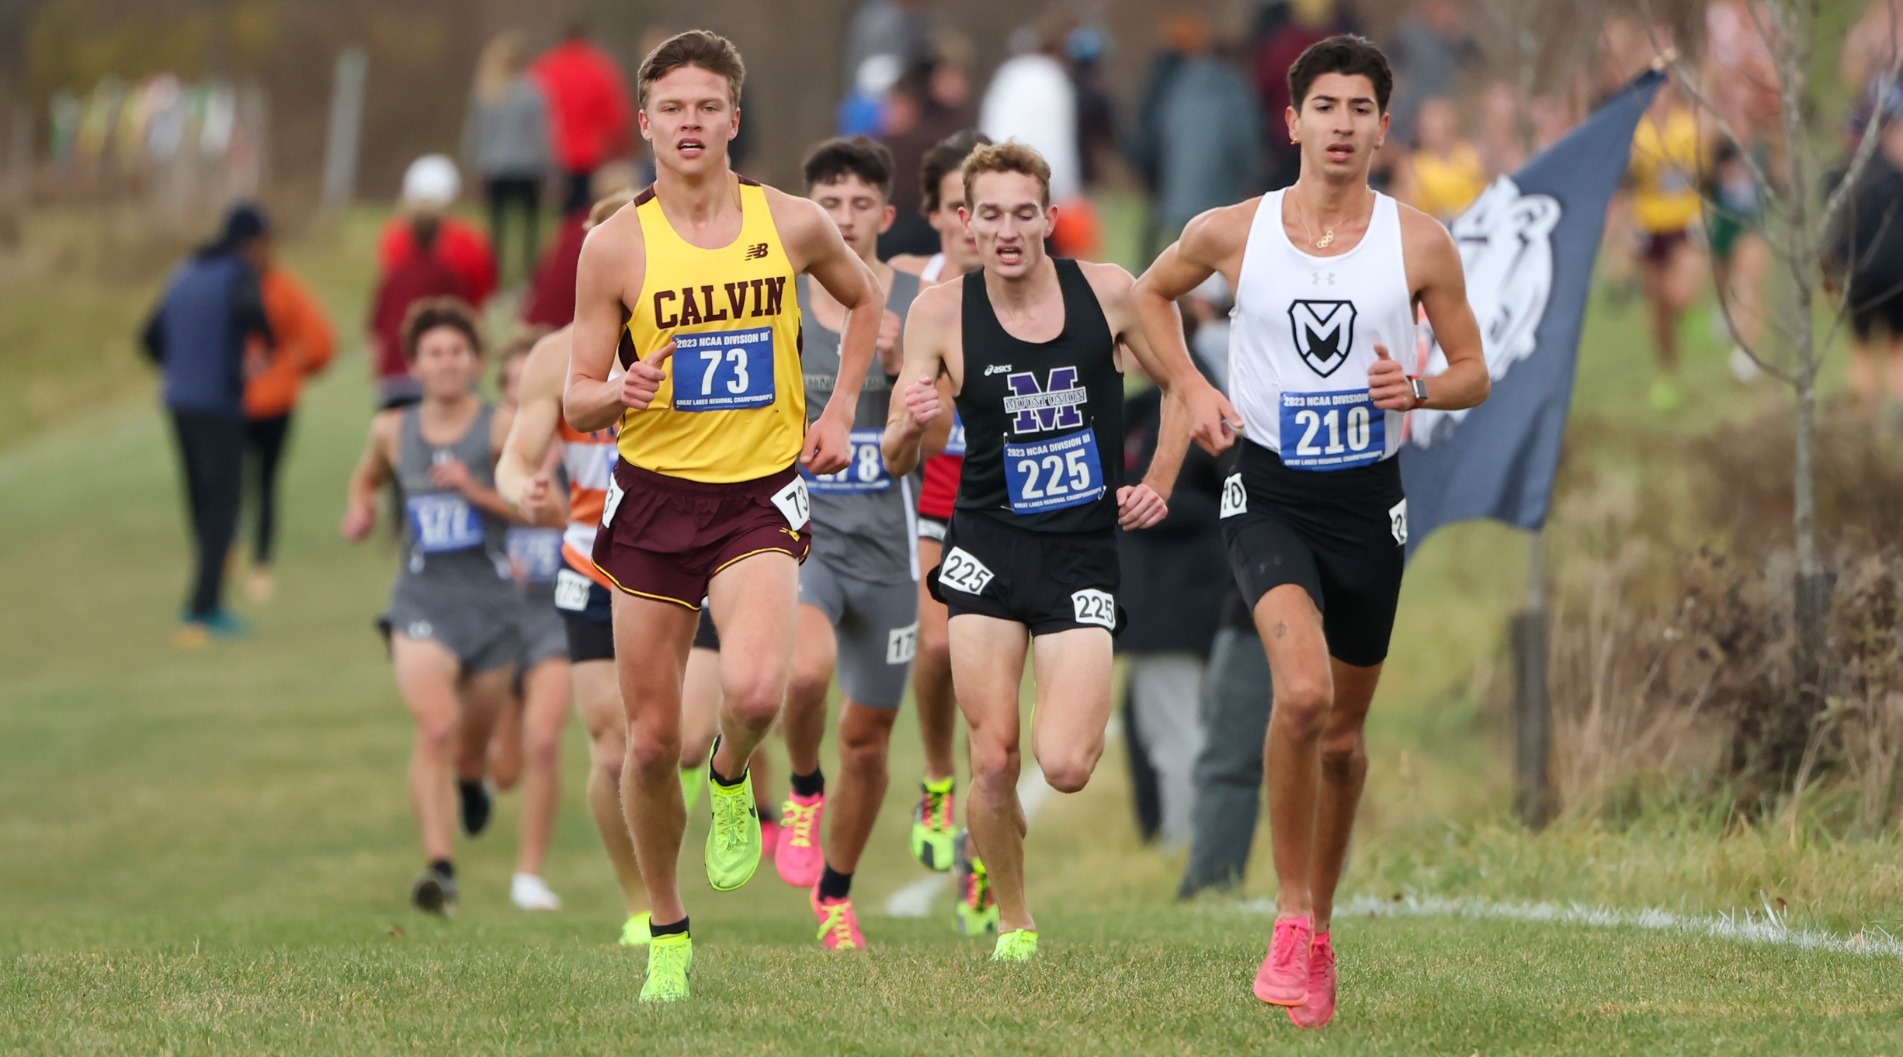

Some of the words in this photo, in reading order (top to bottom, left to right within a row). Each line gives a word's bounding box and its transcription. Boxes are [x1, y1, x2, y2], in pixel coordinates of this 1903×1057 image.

[653, 276, 786, 330] CALVIN
[677, 339, 697, 348] 2023
[699, 336, 722, 346] NCAA
[724, 334, 759, 345] DIVISION
[760, 332, 769, 341] III
[700, 348, 749, 395] 73
[992, 364, 1012, 374] asics
[676, 398, 692, 406] GREAT
[734, 394, 773, 403] CHAMPIONSHIPS
[1283, 397, 1305, 406] 2023
[1306, 395, 1331, 406] NCAA
[1332, 393, 1369, 405] DIVISION
[1007, 448, 1025, 457] 2023
[1026, 445, 1048, 456] NCAA
[1049, 437, 1082, 452] DIVISION
[1082, 433, 1091, 444] III
[1295, 406, 1370, 456] 210
[1017, 448, 1090, 499] 225
[785, 485, 808, 519] 73
[944, 555, 990, 593] 225
[1076, 595, 1114, 624] 225
